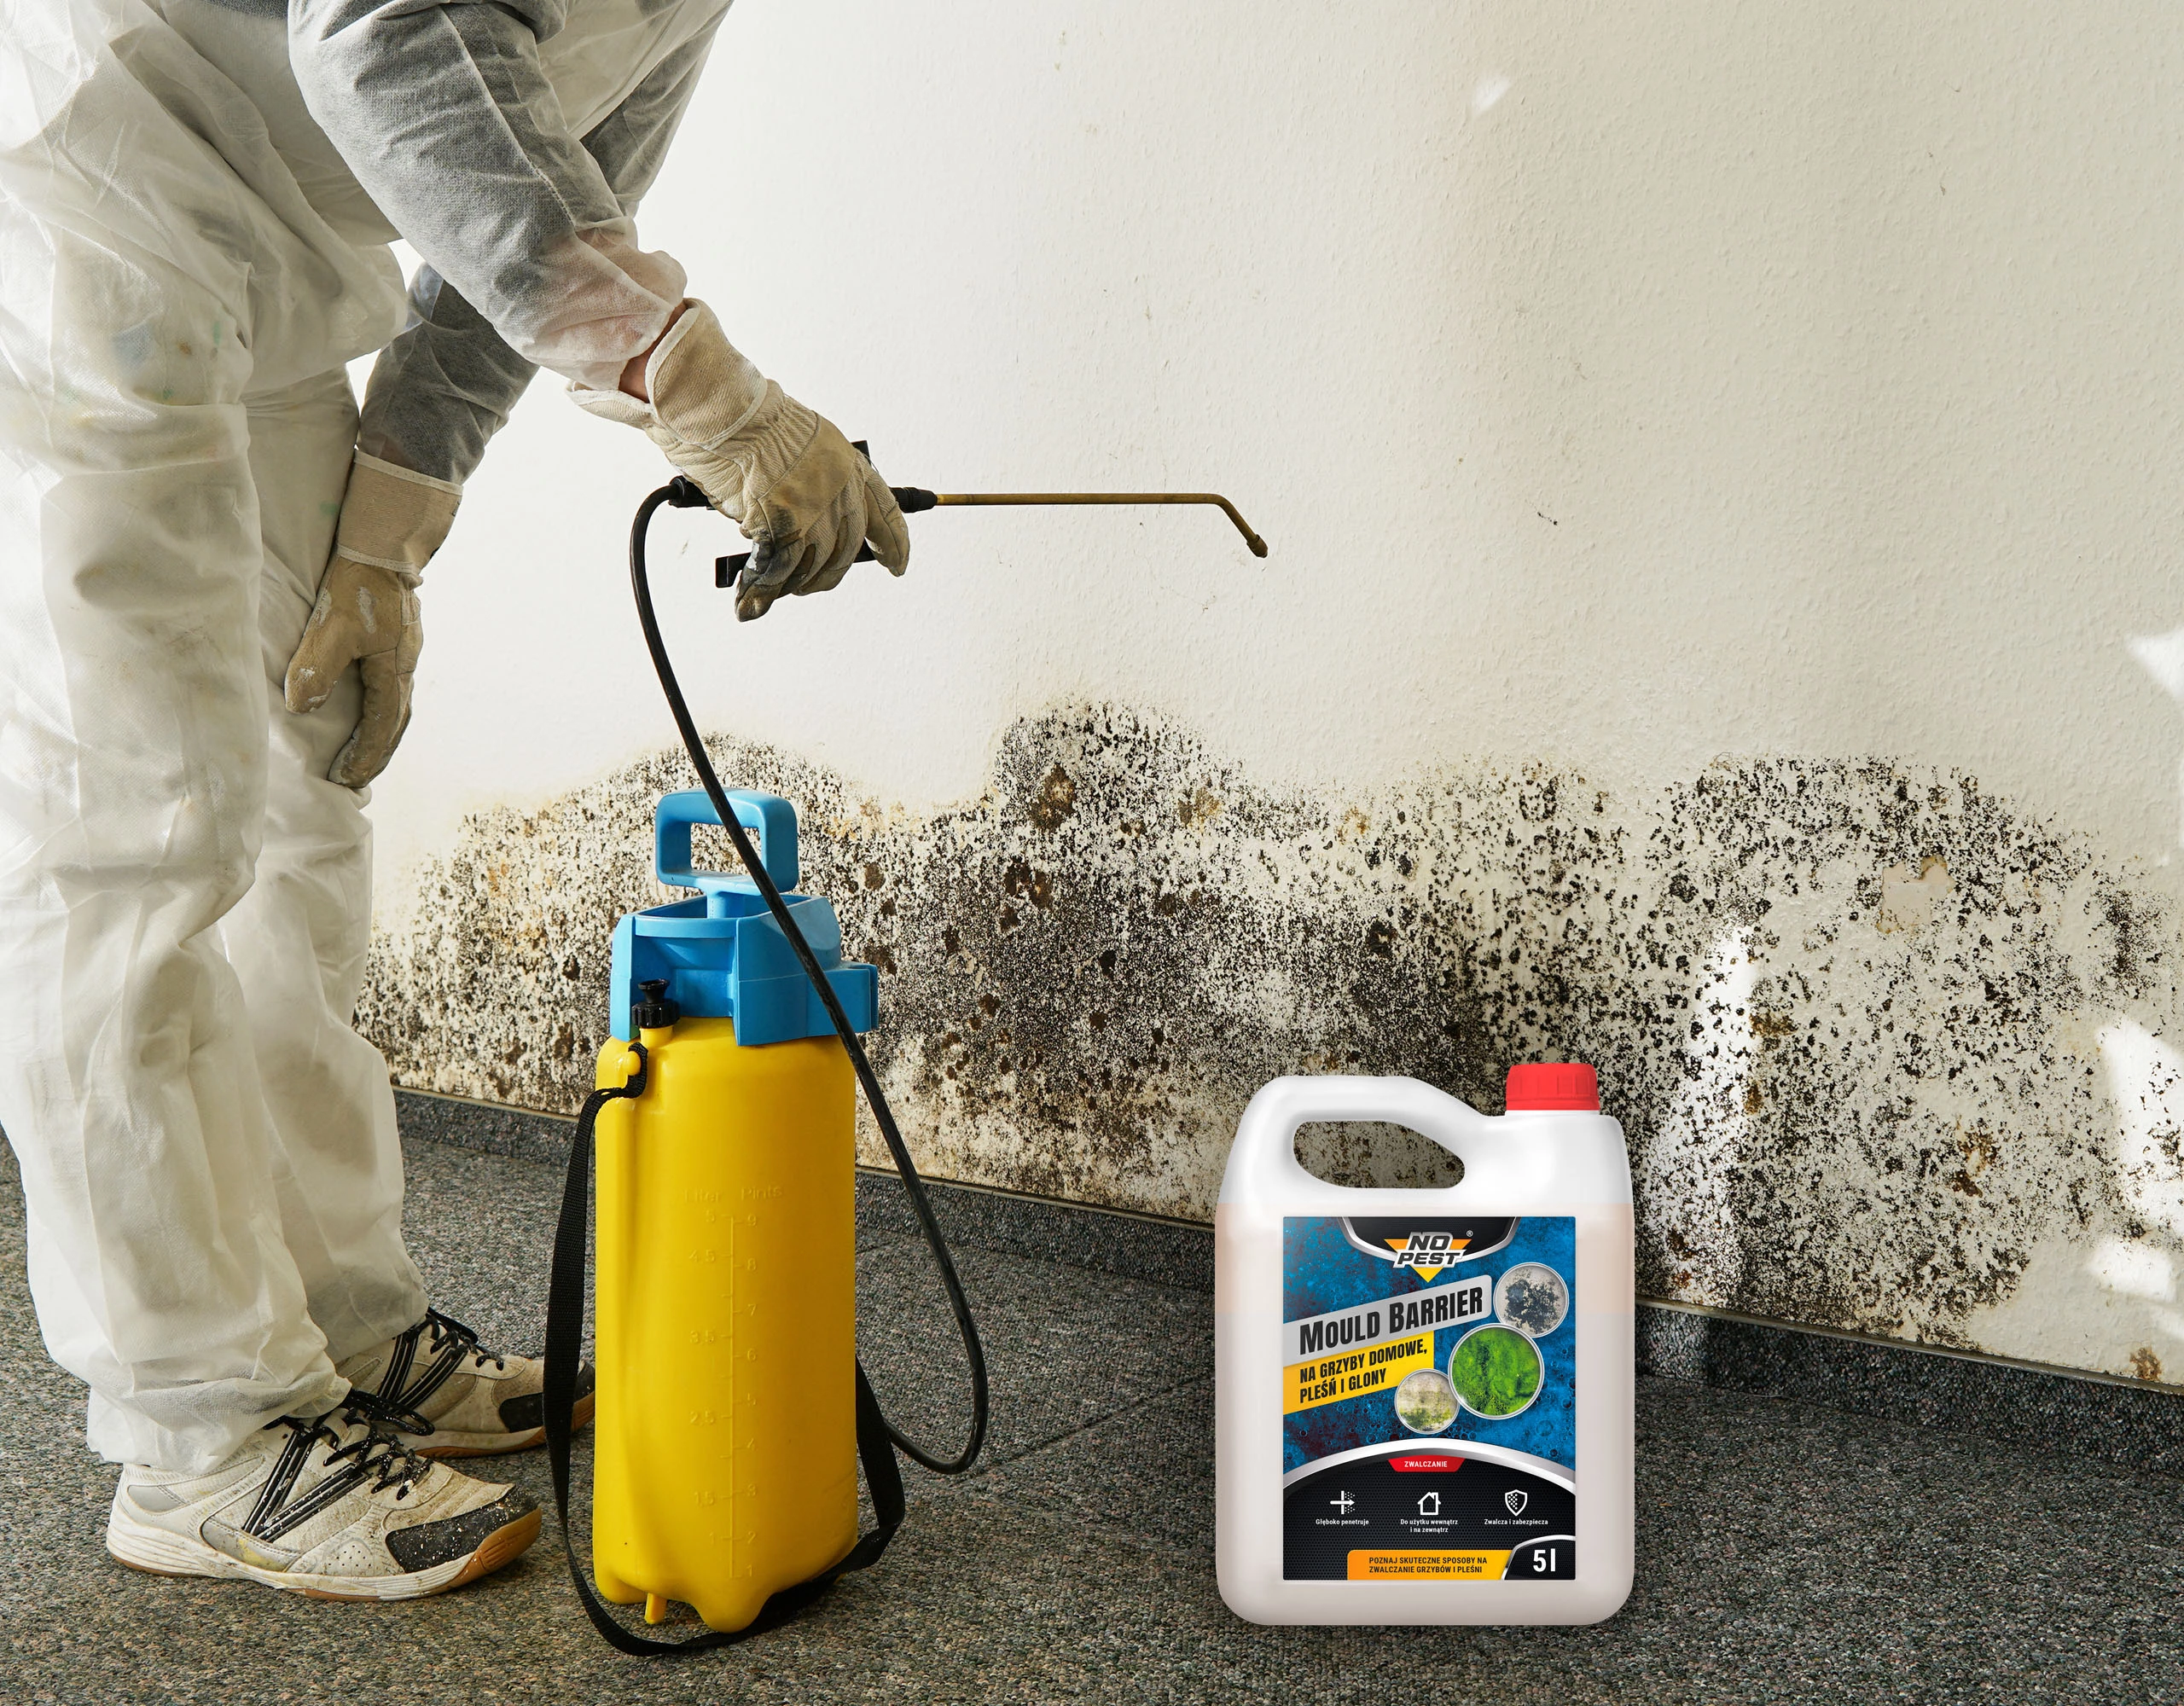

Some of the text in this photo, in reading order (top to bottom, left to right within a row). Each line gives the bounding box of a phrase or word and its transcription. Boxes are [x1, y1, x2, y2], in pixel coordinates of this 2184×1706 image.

[741, 1184, 784, 1202] Pints
[705, 1209, 716, 1223] 5
[747, 1213, 757, 1227] 9
[1409, 1234, 1450, 1250] NO
[747, 1257, 757, 1272] 8
[1397, 1252, 1461, 1265] PEST
[747, 1303, 758, 1316] 7
[1299, 1286, 1484, 1355] MOULD BARRIER
[747, 1348, 758, 1361] 6
[1299, 1338, 1427, 1384] NA GRZYBY DOMOWE,
[1299, 1367, 1387, 1404] PLEŚŃ I GLONY
[746, 1392, 757, 1406] 5
[746, 1437, 757, 1451] 4
[747, 1483, 758, 1498] 3
[1316, 1518, 1369, 1527] Głęboko penetruje
[1409, 1518, 1429, 1527] użytku
[1431, 1518, 1458, 1527] wewnątrz
[1513, 1518, 1548, 1527] zabezpiecza
[747, 1530, 758, 1544] 2
[1422, 1526, 1449, 1535] zewnątrz
[1368, 1557, 1397, 1565] POZNAJ
[1368, 1565, 1414, 1574] ZWALCZANIE
[1416, 1564, 1451, 1574] GRZYBÓW
[1457, 1564, 1483, 1574] PLEŚNI
